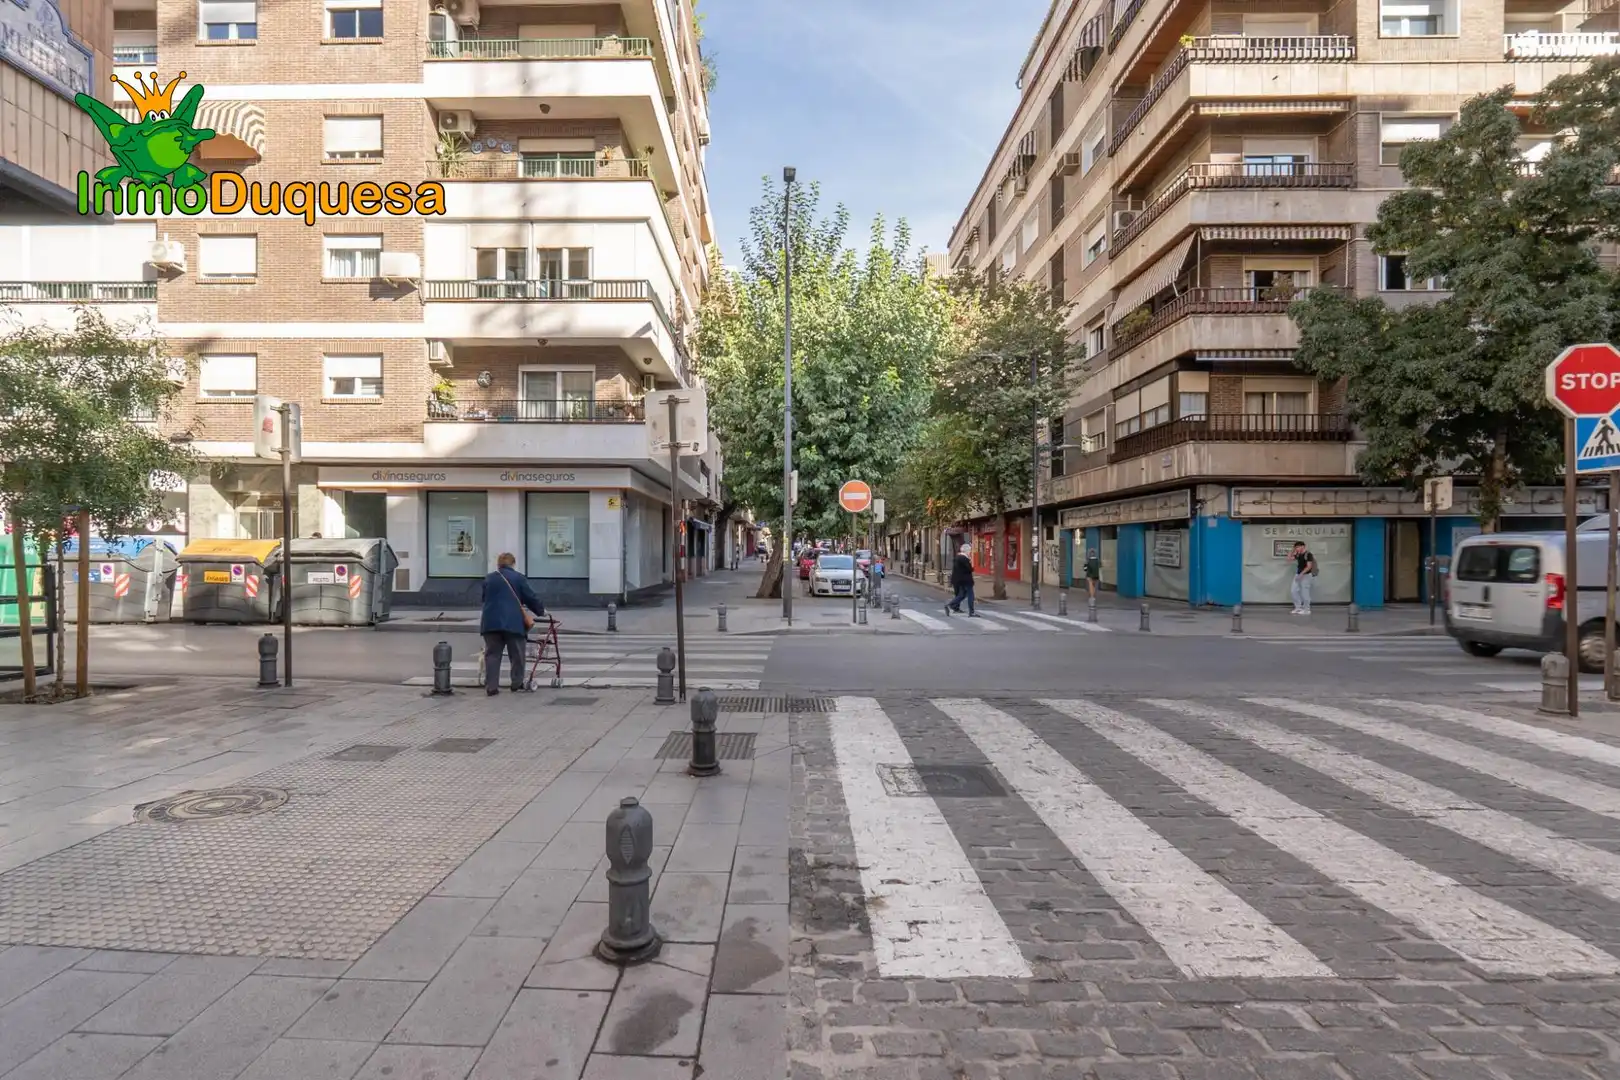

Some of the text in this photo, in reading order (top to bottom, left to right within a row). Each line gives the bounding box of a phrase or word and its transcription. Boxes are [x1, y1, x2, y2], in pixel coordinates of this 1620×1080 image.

[1560, 372, 1620, 390] STOP
[371, 469, 446, 482] divinaseguros
[500, 470, 575, 484] divinaseguros
[1264, 527, 1345, 535] SE ALQUILA
